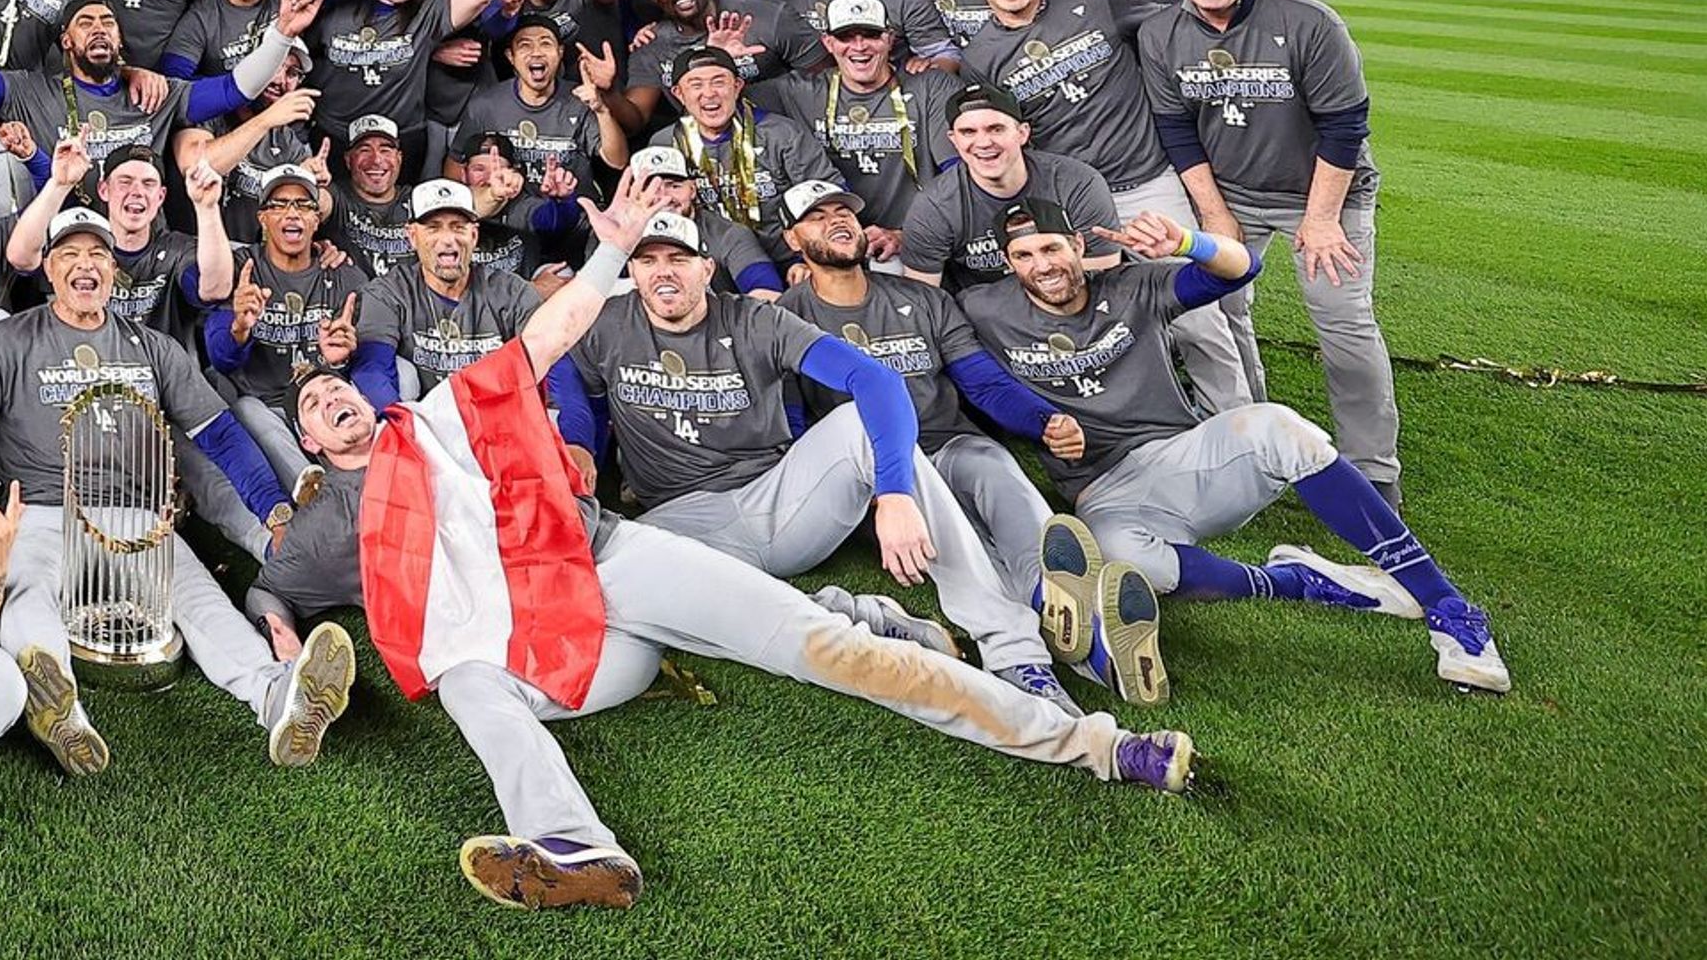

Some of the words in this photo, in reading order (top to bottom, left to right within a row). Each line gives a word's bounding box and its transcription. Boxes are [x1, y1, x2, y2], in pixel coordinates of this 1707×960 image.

[331, 36, 371, 53] WORLD
[1003, 54, 1053, 86] WORLD
[1047, 37, 1105, 67] SERIES
[1177, 65, 1230, 87] WORLD
[1232, 67, 1290, 86] SERIES
[1180, 79, 1294, 100] CHAMPIONS
[870, 337, 927, 356] SERIES
[1004, 347, 1062, 367] WORLD
[1060, 321, 1131, 354] SERIES
[38, 367, 99, 385] WORLD
[99, 367, 153, 381] SERIES
[619, 366, 683, 391] WORLD
[682, 372, 744, 391] SERIES
[616, 382, 750, 413] CHAMPIONS
